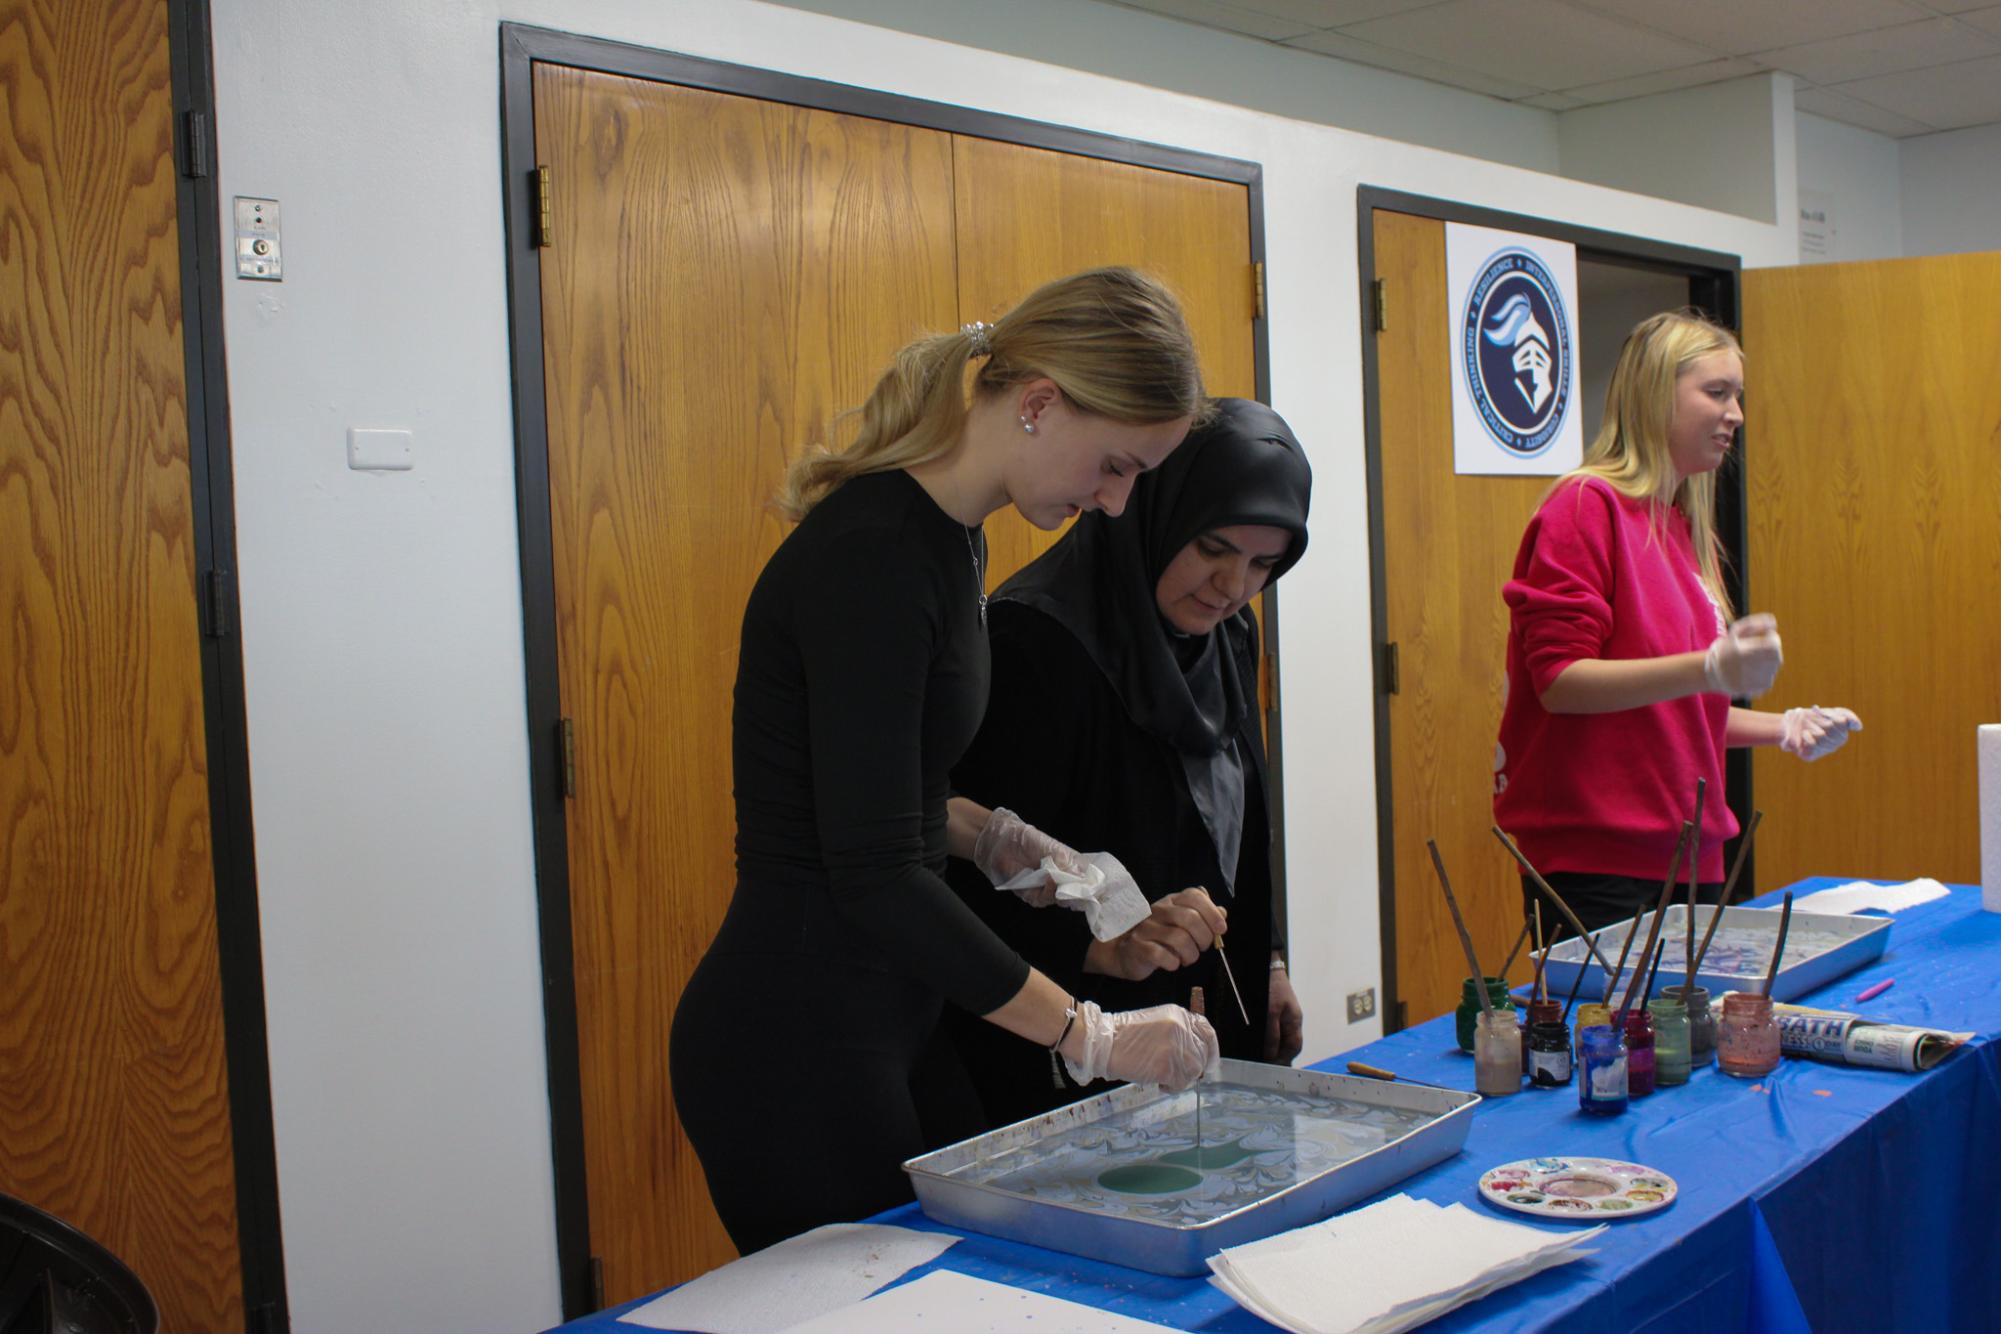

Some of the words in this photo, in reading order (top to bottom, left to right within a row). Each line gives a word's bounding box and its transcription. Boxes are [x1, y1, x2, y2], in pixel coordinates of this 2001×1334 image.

[1473, 257, 1514, 306] RESILIENCE
[1467, 327, 1482, 399] THINKING
[1479, 399, 1513, 443] CRITICAL
